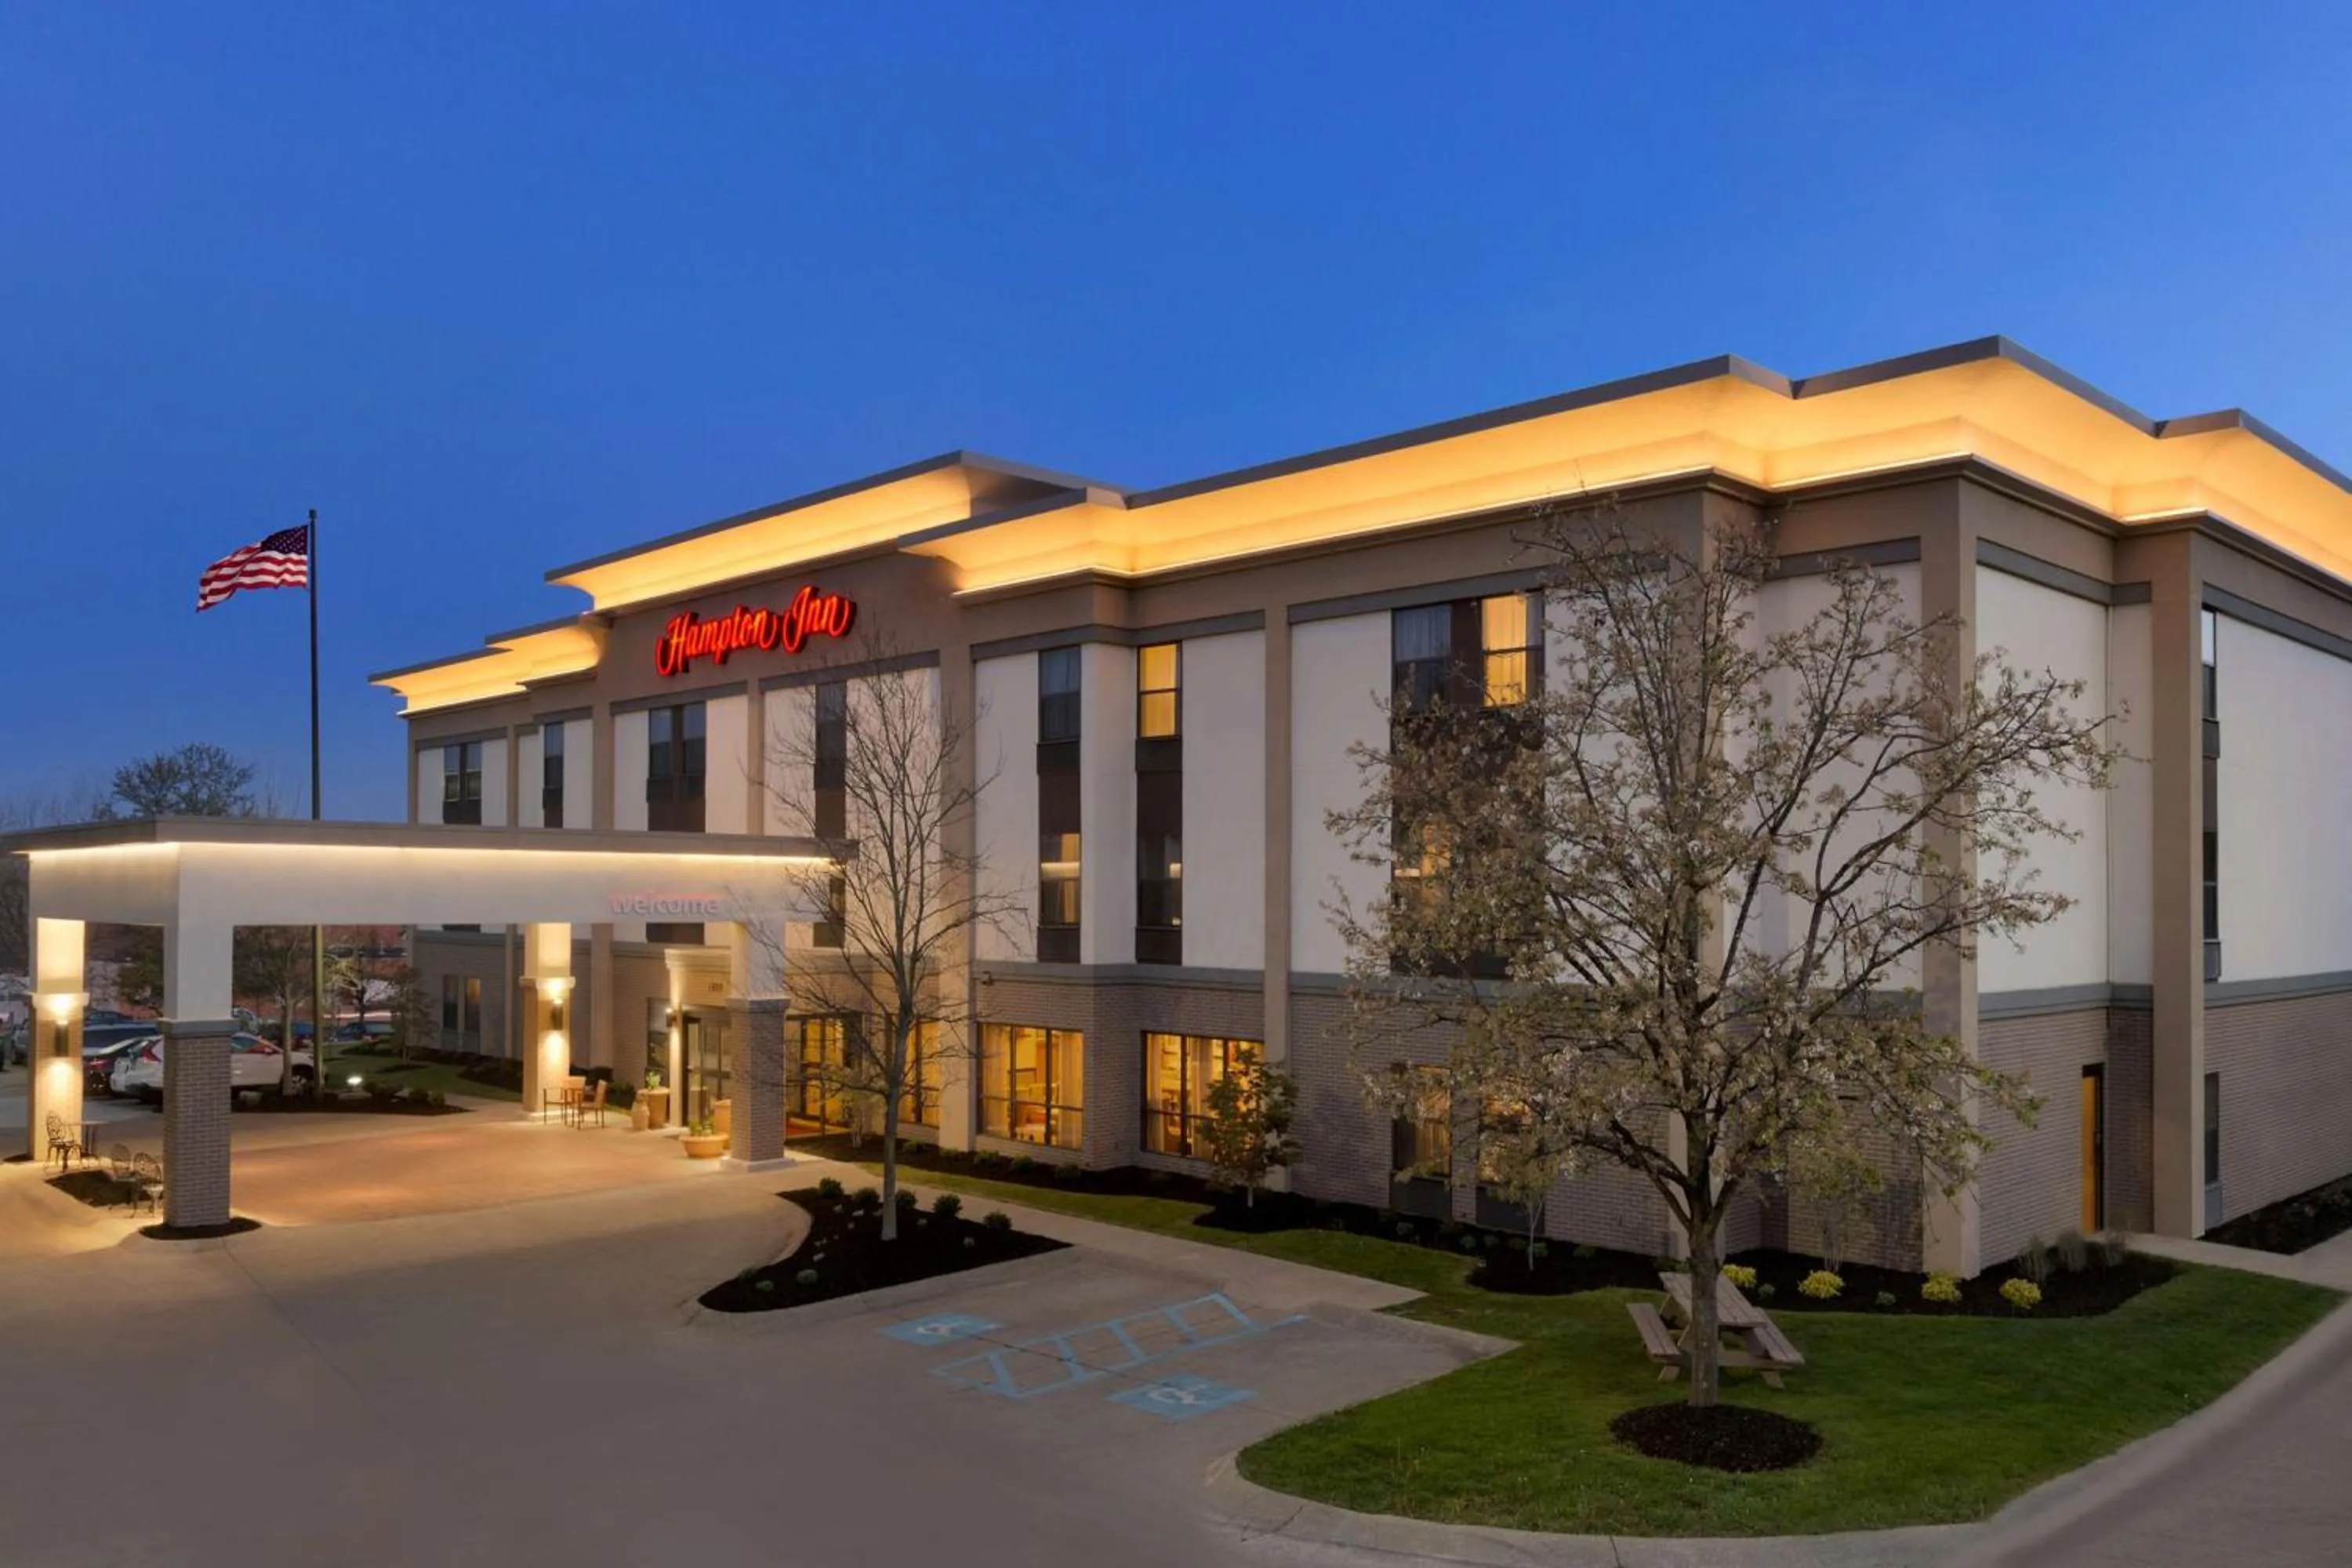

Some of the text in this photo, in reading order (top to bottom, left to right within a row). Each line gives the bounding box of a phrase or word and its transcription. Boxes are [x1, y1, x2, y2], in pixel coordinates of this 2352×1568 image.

[655, 584, 852, 676] Hampton Inn
[608, 891, 720, 916] welcome
